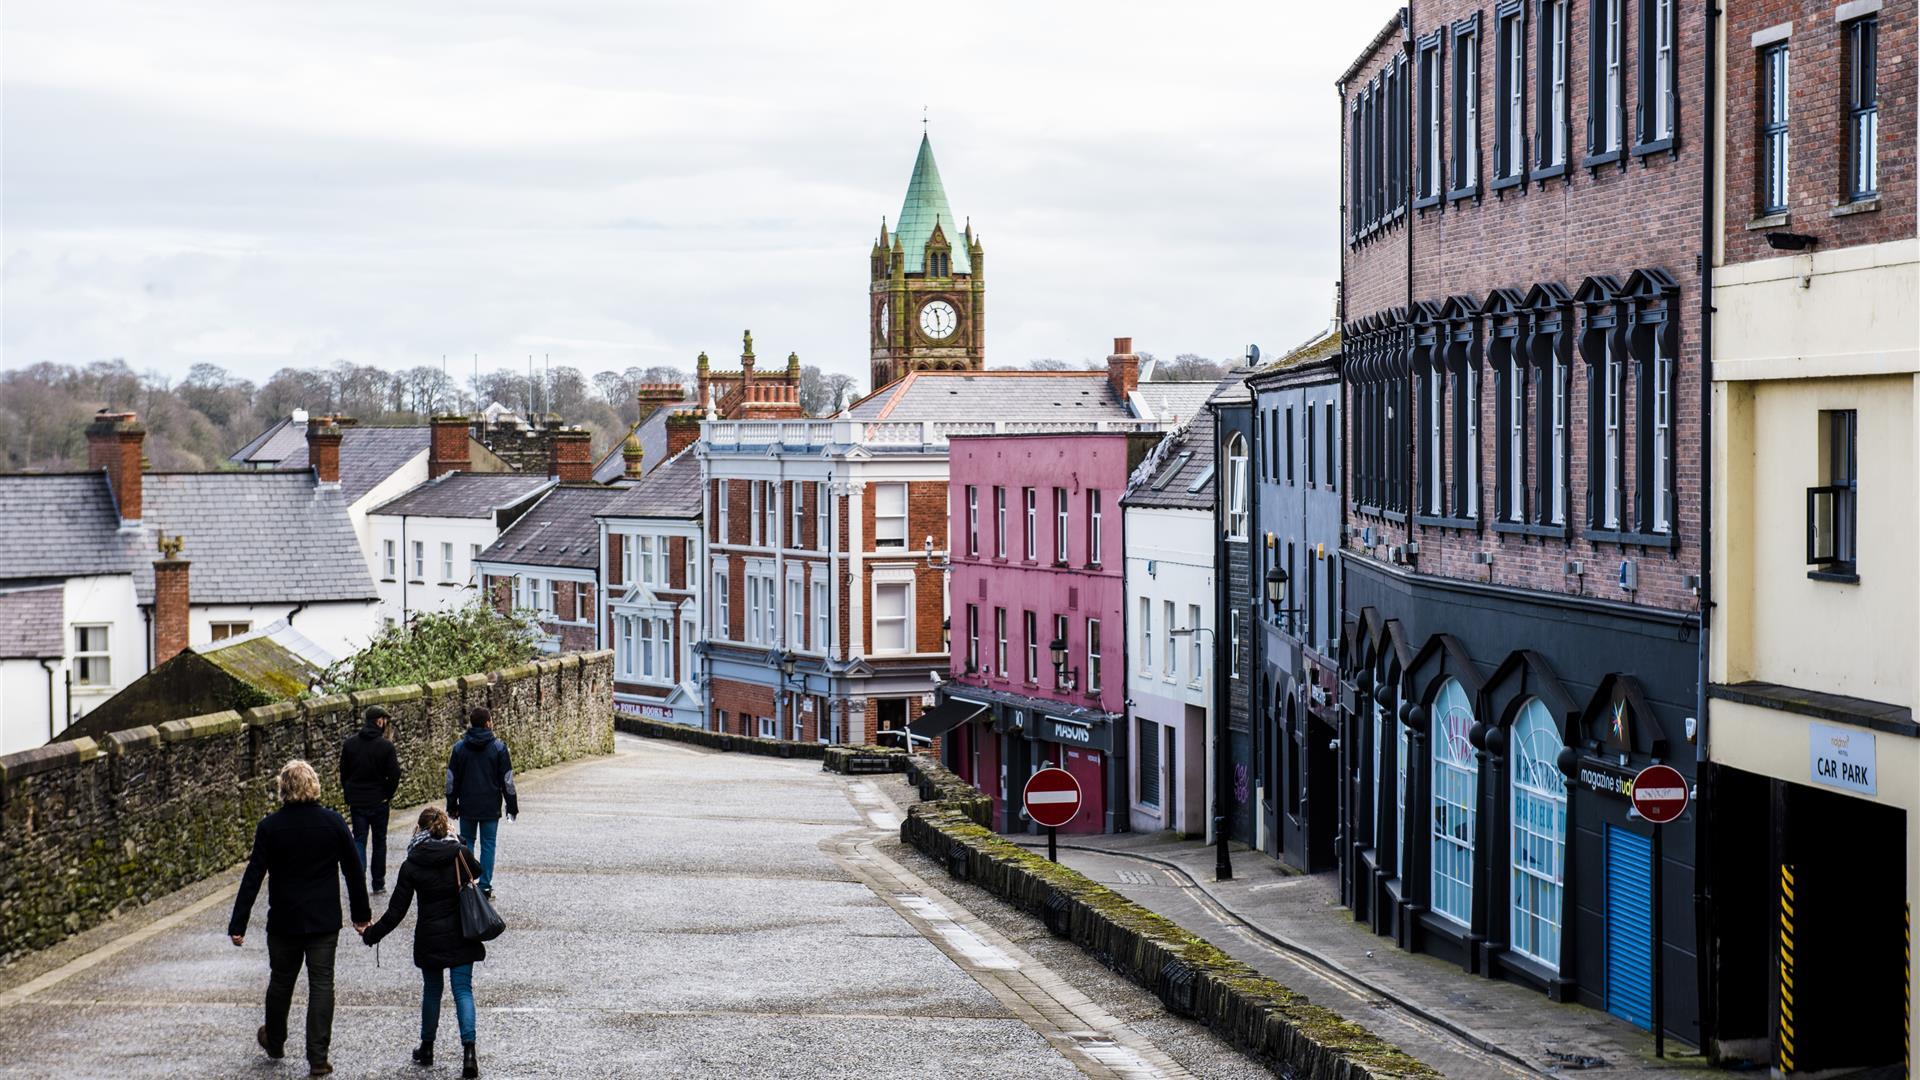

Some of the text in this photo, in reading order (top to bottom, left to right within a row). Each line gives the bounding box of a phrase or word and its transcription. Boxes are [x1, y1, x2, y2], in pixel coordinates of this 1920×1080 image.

[1055, 723, 1089, 742] MASONS
[1581, 768, 1614, 791] magazine
[1615, 776, 1633, 796] studi
[1817, 757, 1869, 786] CAR PARK
